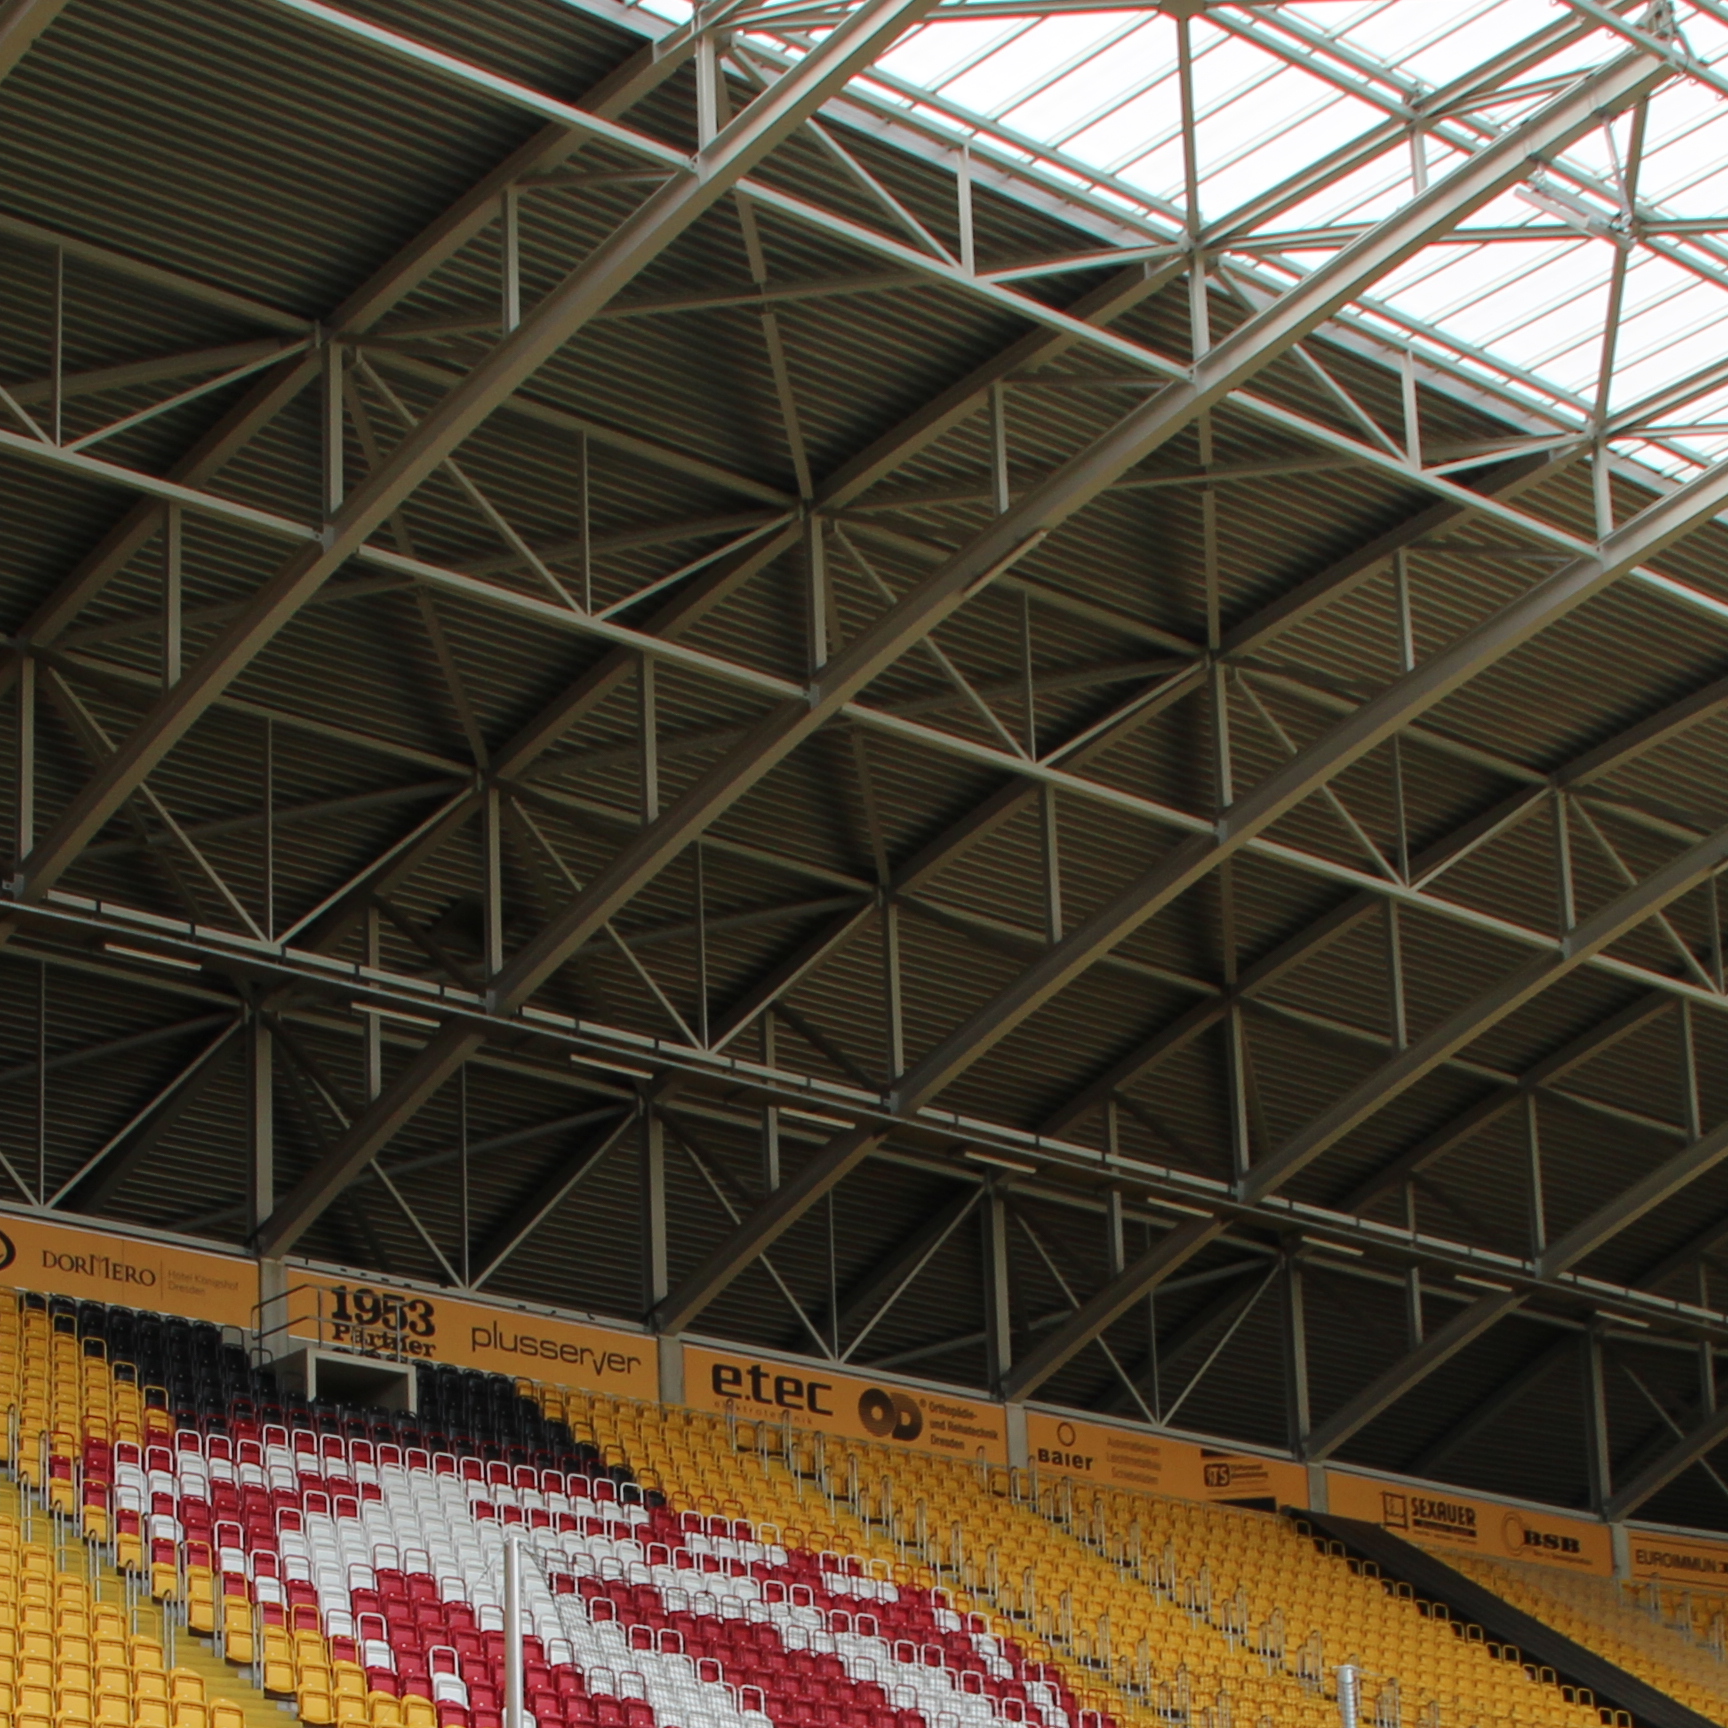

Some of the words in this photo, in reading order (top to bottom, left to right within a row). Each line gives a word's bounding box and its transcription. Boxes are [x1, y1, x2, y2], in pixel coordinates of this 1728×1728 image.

[330, 1285, 436, 1337] 1953
[471, 1320, 642, 1377] plusserver
[711, 1363, 834, 1416] e.tec
[1411, 1497, 1477, 1528] SEXAUER
[1523, 1530, 1581, 1554] BSB
